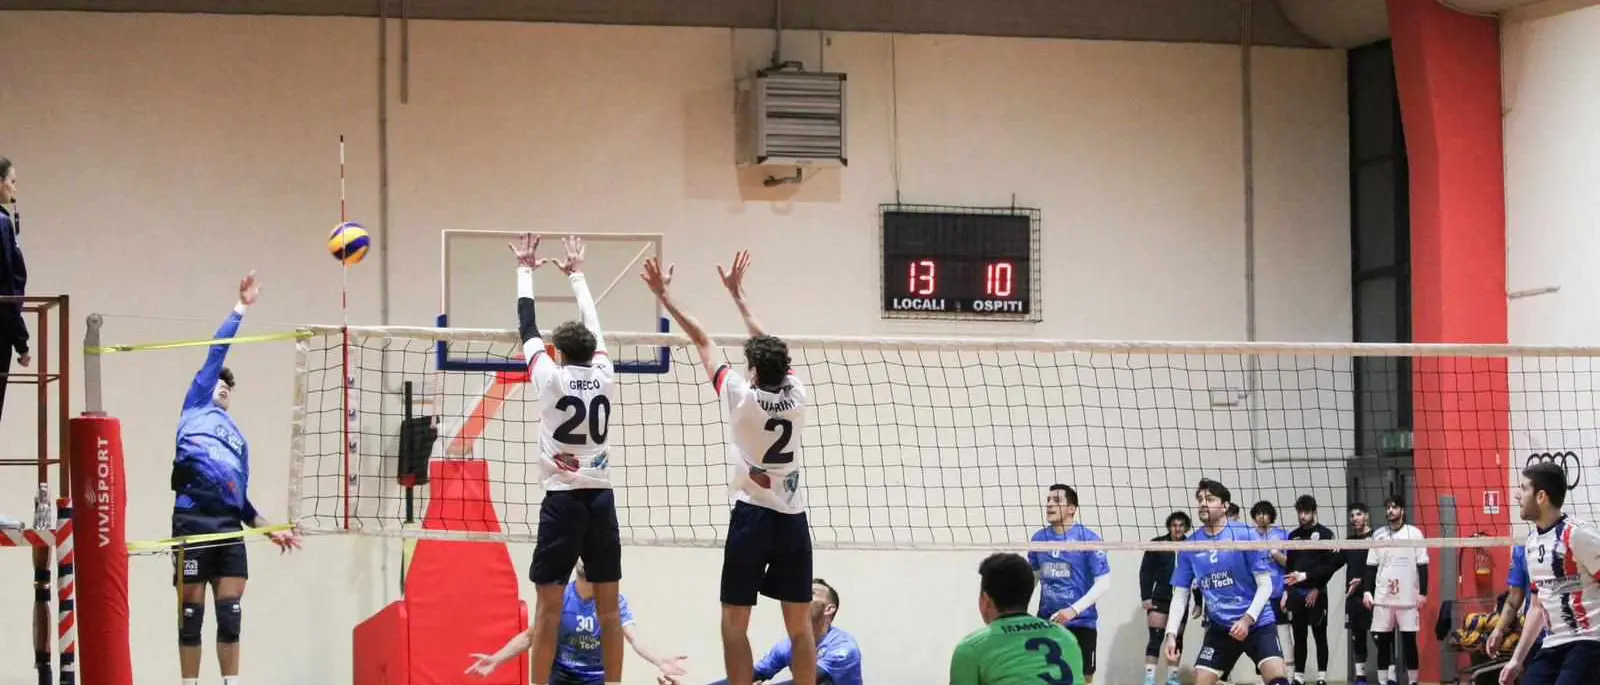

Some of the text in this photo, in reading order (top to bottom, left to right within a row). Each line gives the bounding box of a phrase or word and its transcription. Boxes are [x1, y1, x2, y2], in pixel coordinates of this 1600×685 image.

[909, 260, 1012, 297] 13 10
[893, 298, 945, 310] LOCALI
[973, 300, 1023, 312] OSPITI
[569, 379, 601, 391] GRECO
[552, 394, 611, 445] 20
[761, 418, 794, 464] 2
[97, 436, 110, 548] VIVISPORT
[1537, 544, 1546, 564] 9
[1212, 577, 1233, 588] Tech
[575, 614, 594, 633] 30
[1024, 637, 1074, 685] 3
